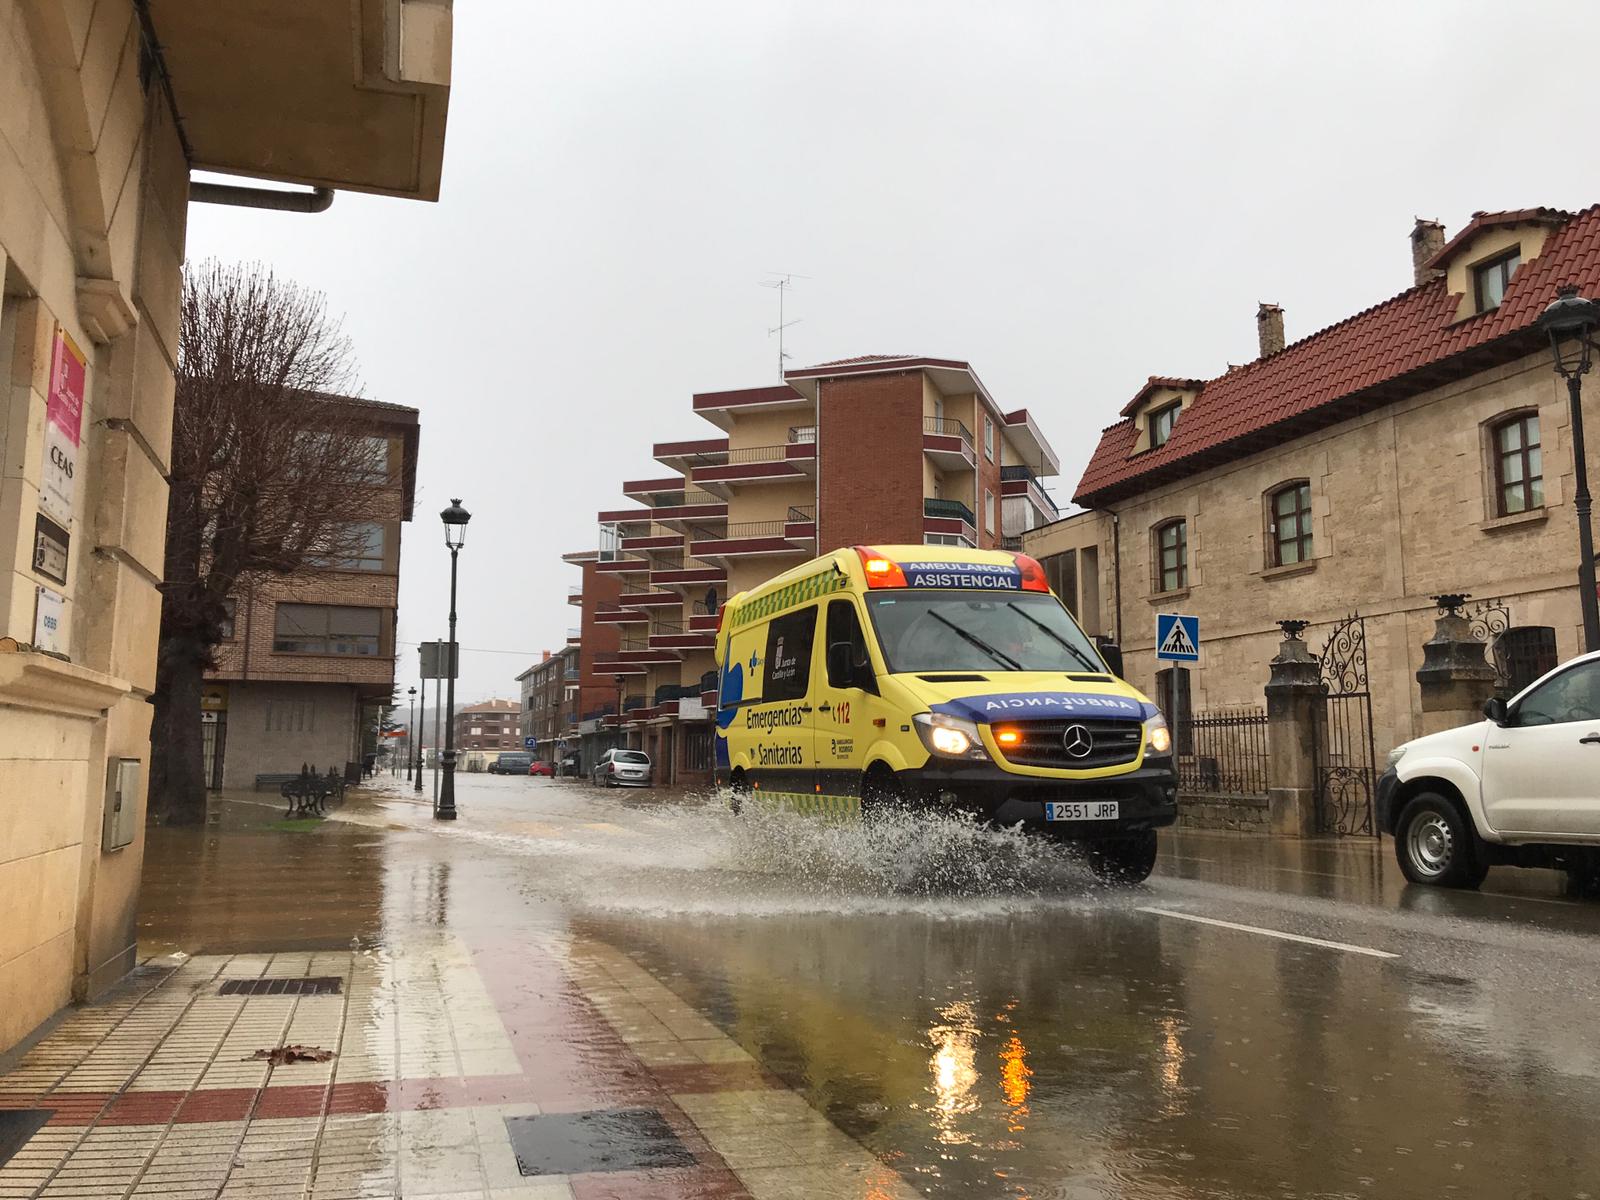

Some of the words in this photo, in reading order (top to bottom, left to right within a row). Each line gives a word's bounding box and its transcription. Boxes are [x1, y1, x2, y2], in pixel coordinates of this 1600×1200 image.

[51, 446, 74, 479] CEAS
[909, 562, 1016, 575] AMBULANCIA
[914, 574, 1018, 589] ASISTENCIAL
[746, 702, 803, 735] Emergencias
[836, 701, 851, 724] 112
[758, 740, 803, 766] Sanitarias
[1056, 804, 1089, 819] 2551
[1094, 804, 1117, 818] JRP
